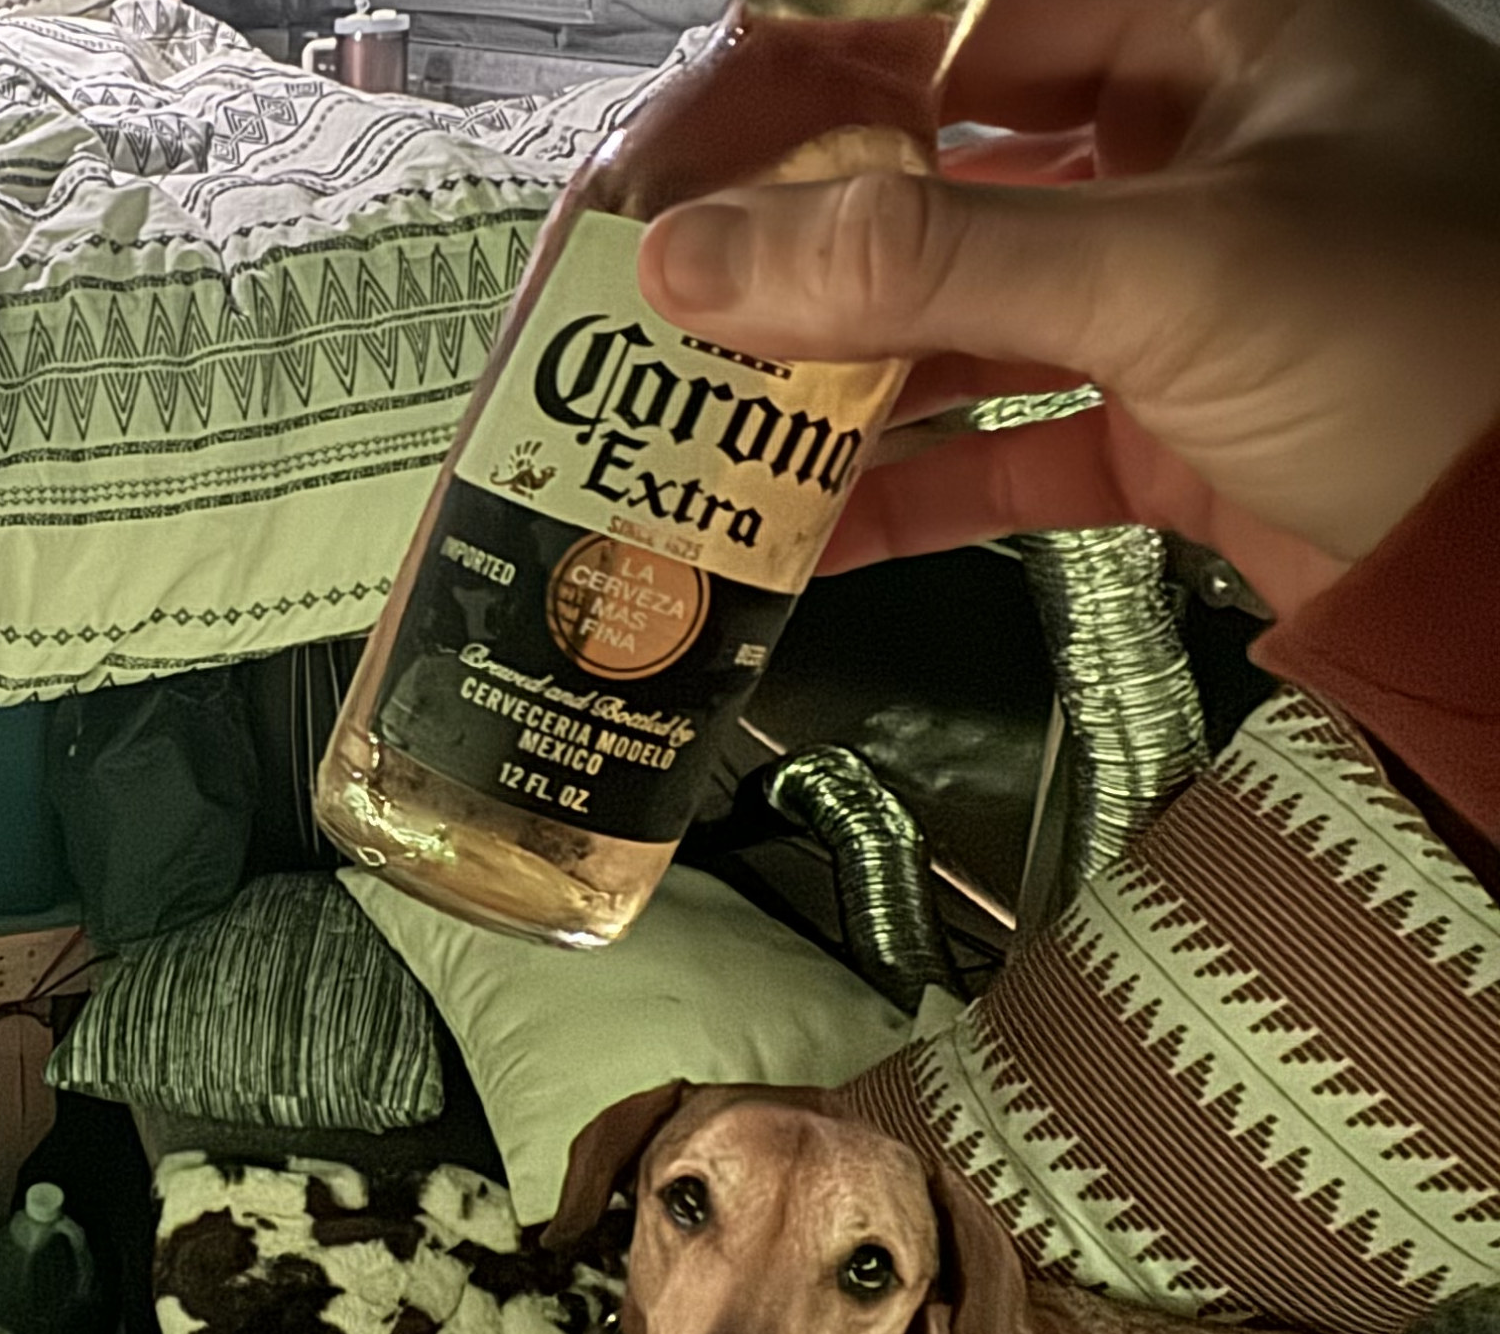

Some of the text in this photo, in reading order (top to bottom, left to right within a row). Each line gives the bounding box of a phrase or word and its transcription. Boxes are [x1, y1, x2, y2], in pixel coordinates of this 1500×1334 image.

[534, 314, 862, 496] Corona
[580, 429, 763, 548] Extra
[571, 565, 684, 620] CERVEZA
[621, 557, 654, 585] LA
[579, 618, 635, 654] FINA
[458, 643, 554, 693] Brewed
[543, 687, 599, 711] and
[460, 676, 677, 770] CERVECERIA MODELO
[498, 762, 526, 789] 12
[518, 728, 603, 776] MEXICO
